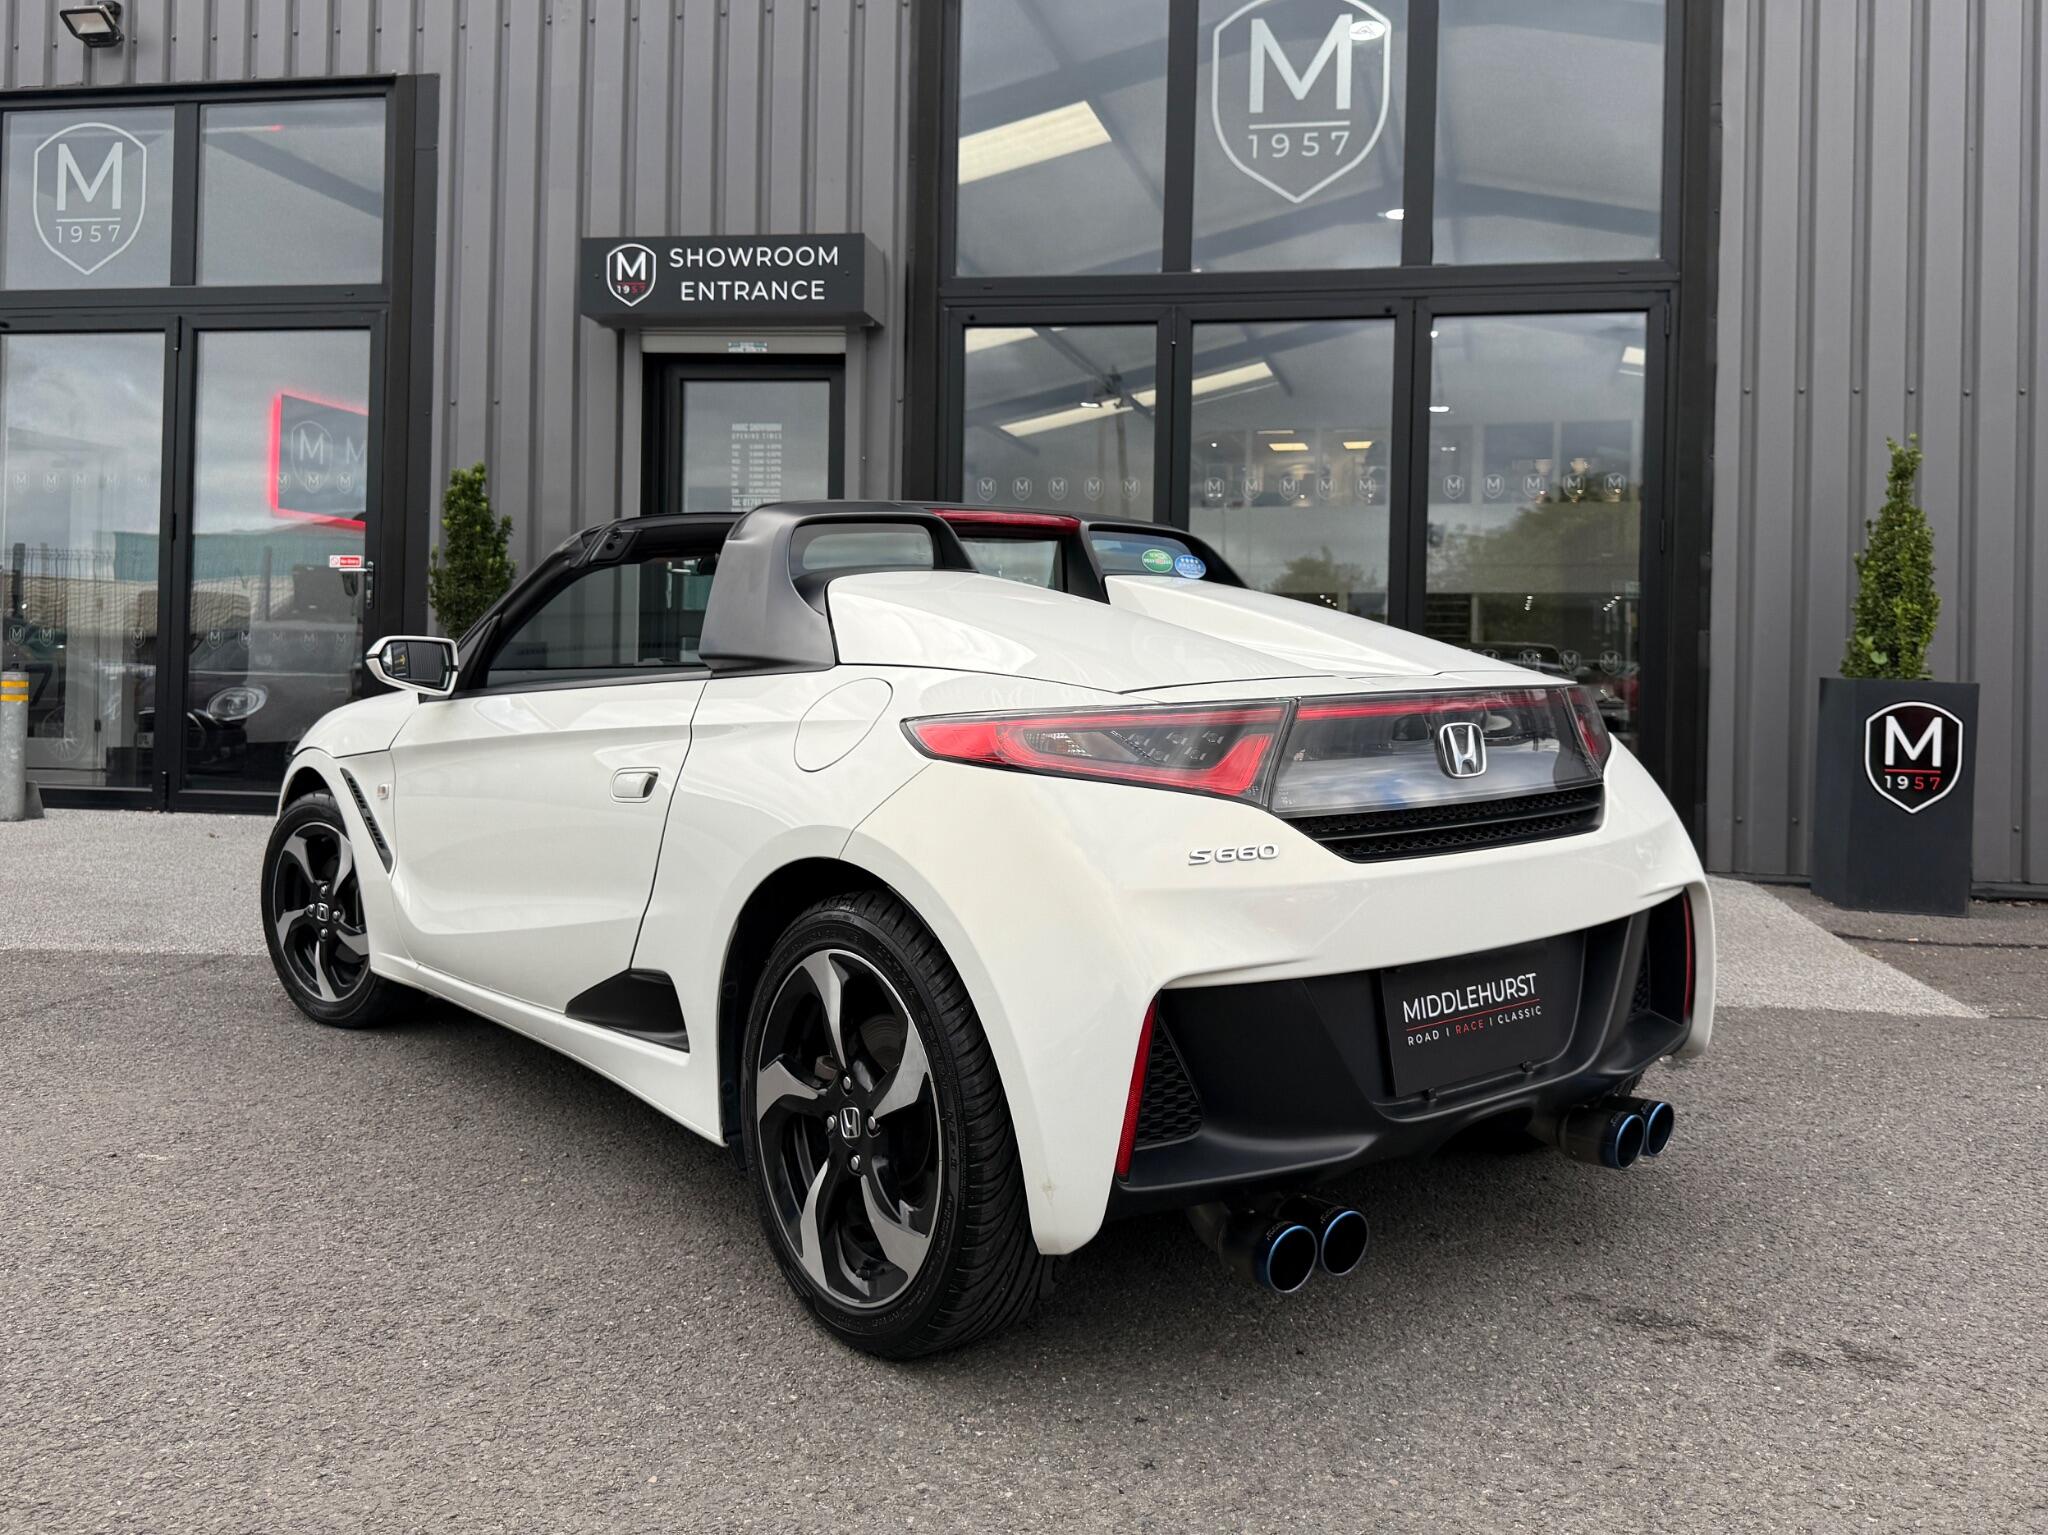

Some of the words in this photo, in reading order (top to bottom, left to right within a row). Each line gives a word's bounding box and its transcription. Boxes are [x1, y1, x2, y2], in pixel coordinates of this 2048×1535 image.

[1249, 13, 1353, 114] M
[1247, 131, 1350, 160] 1957
[56, 142, 124, 212] M
[55, 224, 121, 244] 1957
[616, 251, 647, 281] M
[669, 246, 839, 268] SHOWROOM
[680, 280, 826, 301] ENTRANCE
[1884, 715, 1943, 768] M
[1884, 775, 1942, 791] 1957
[1188, 843, 1280, 866] S660
[1403, 973, 1537, 1022] MIDDLEHURST
[1407, 1030, 1440, 1047] ROAD
[1455, 1020, 1485, 1035] RACE
[1497, 1005, 1543, 1024] CLASSIC
